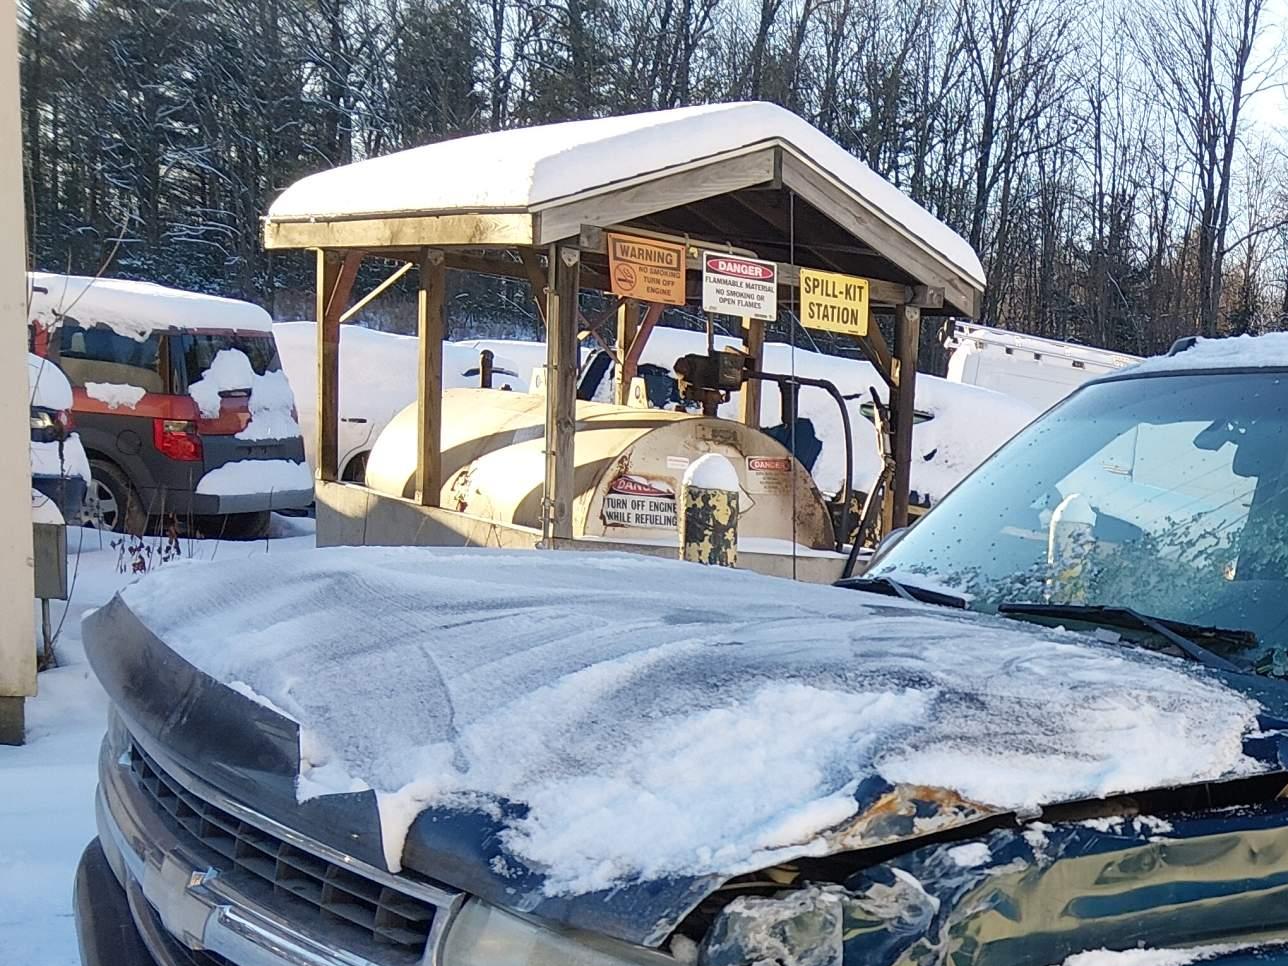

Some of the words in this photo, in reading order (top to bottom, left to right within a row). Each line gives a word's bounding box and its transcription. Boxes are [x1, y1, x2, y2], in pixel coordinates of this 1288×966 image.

[619, 244, 673, 265] WARNING
[639, 266, 648, 274] NO
[649, 267, 680, 279] SMOKING
[718, 260, 762, 277] DANGER
[643, 276, 661, 285] TURN
[662, 279, 674, 287] OFF
[705, 276, 744, 289] FLAMMABLE
[745, 282, 774, 293] MATERIAL
[804, 276, 864, 302] SPILL-KIT
[646, 286, 672, 296] ENGINE
[716, 288, 725, 296] NO
[726, 289, 755, 300] SMOKING
[756, 294, 765, 302] OR
[719, 297, 736, 305] OPEN
[737, 299, 762, 309] FLAMES
[808, 301, 859, 326] STATION
[607, 498, 627, 509] TURN
[631, 500, 645, 511] OFF
[649, 501, 677, 514] ENGINE
[606, 511, 631, 523] WHILE
[635, 513, 678, 527] REFUELING
